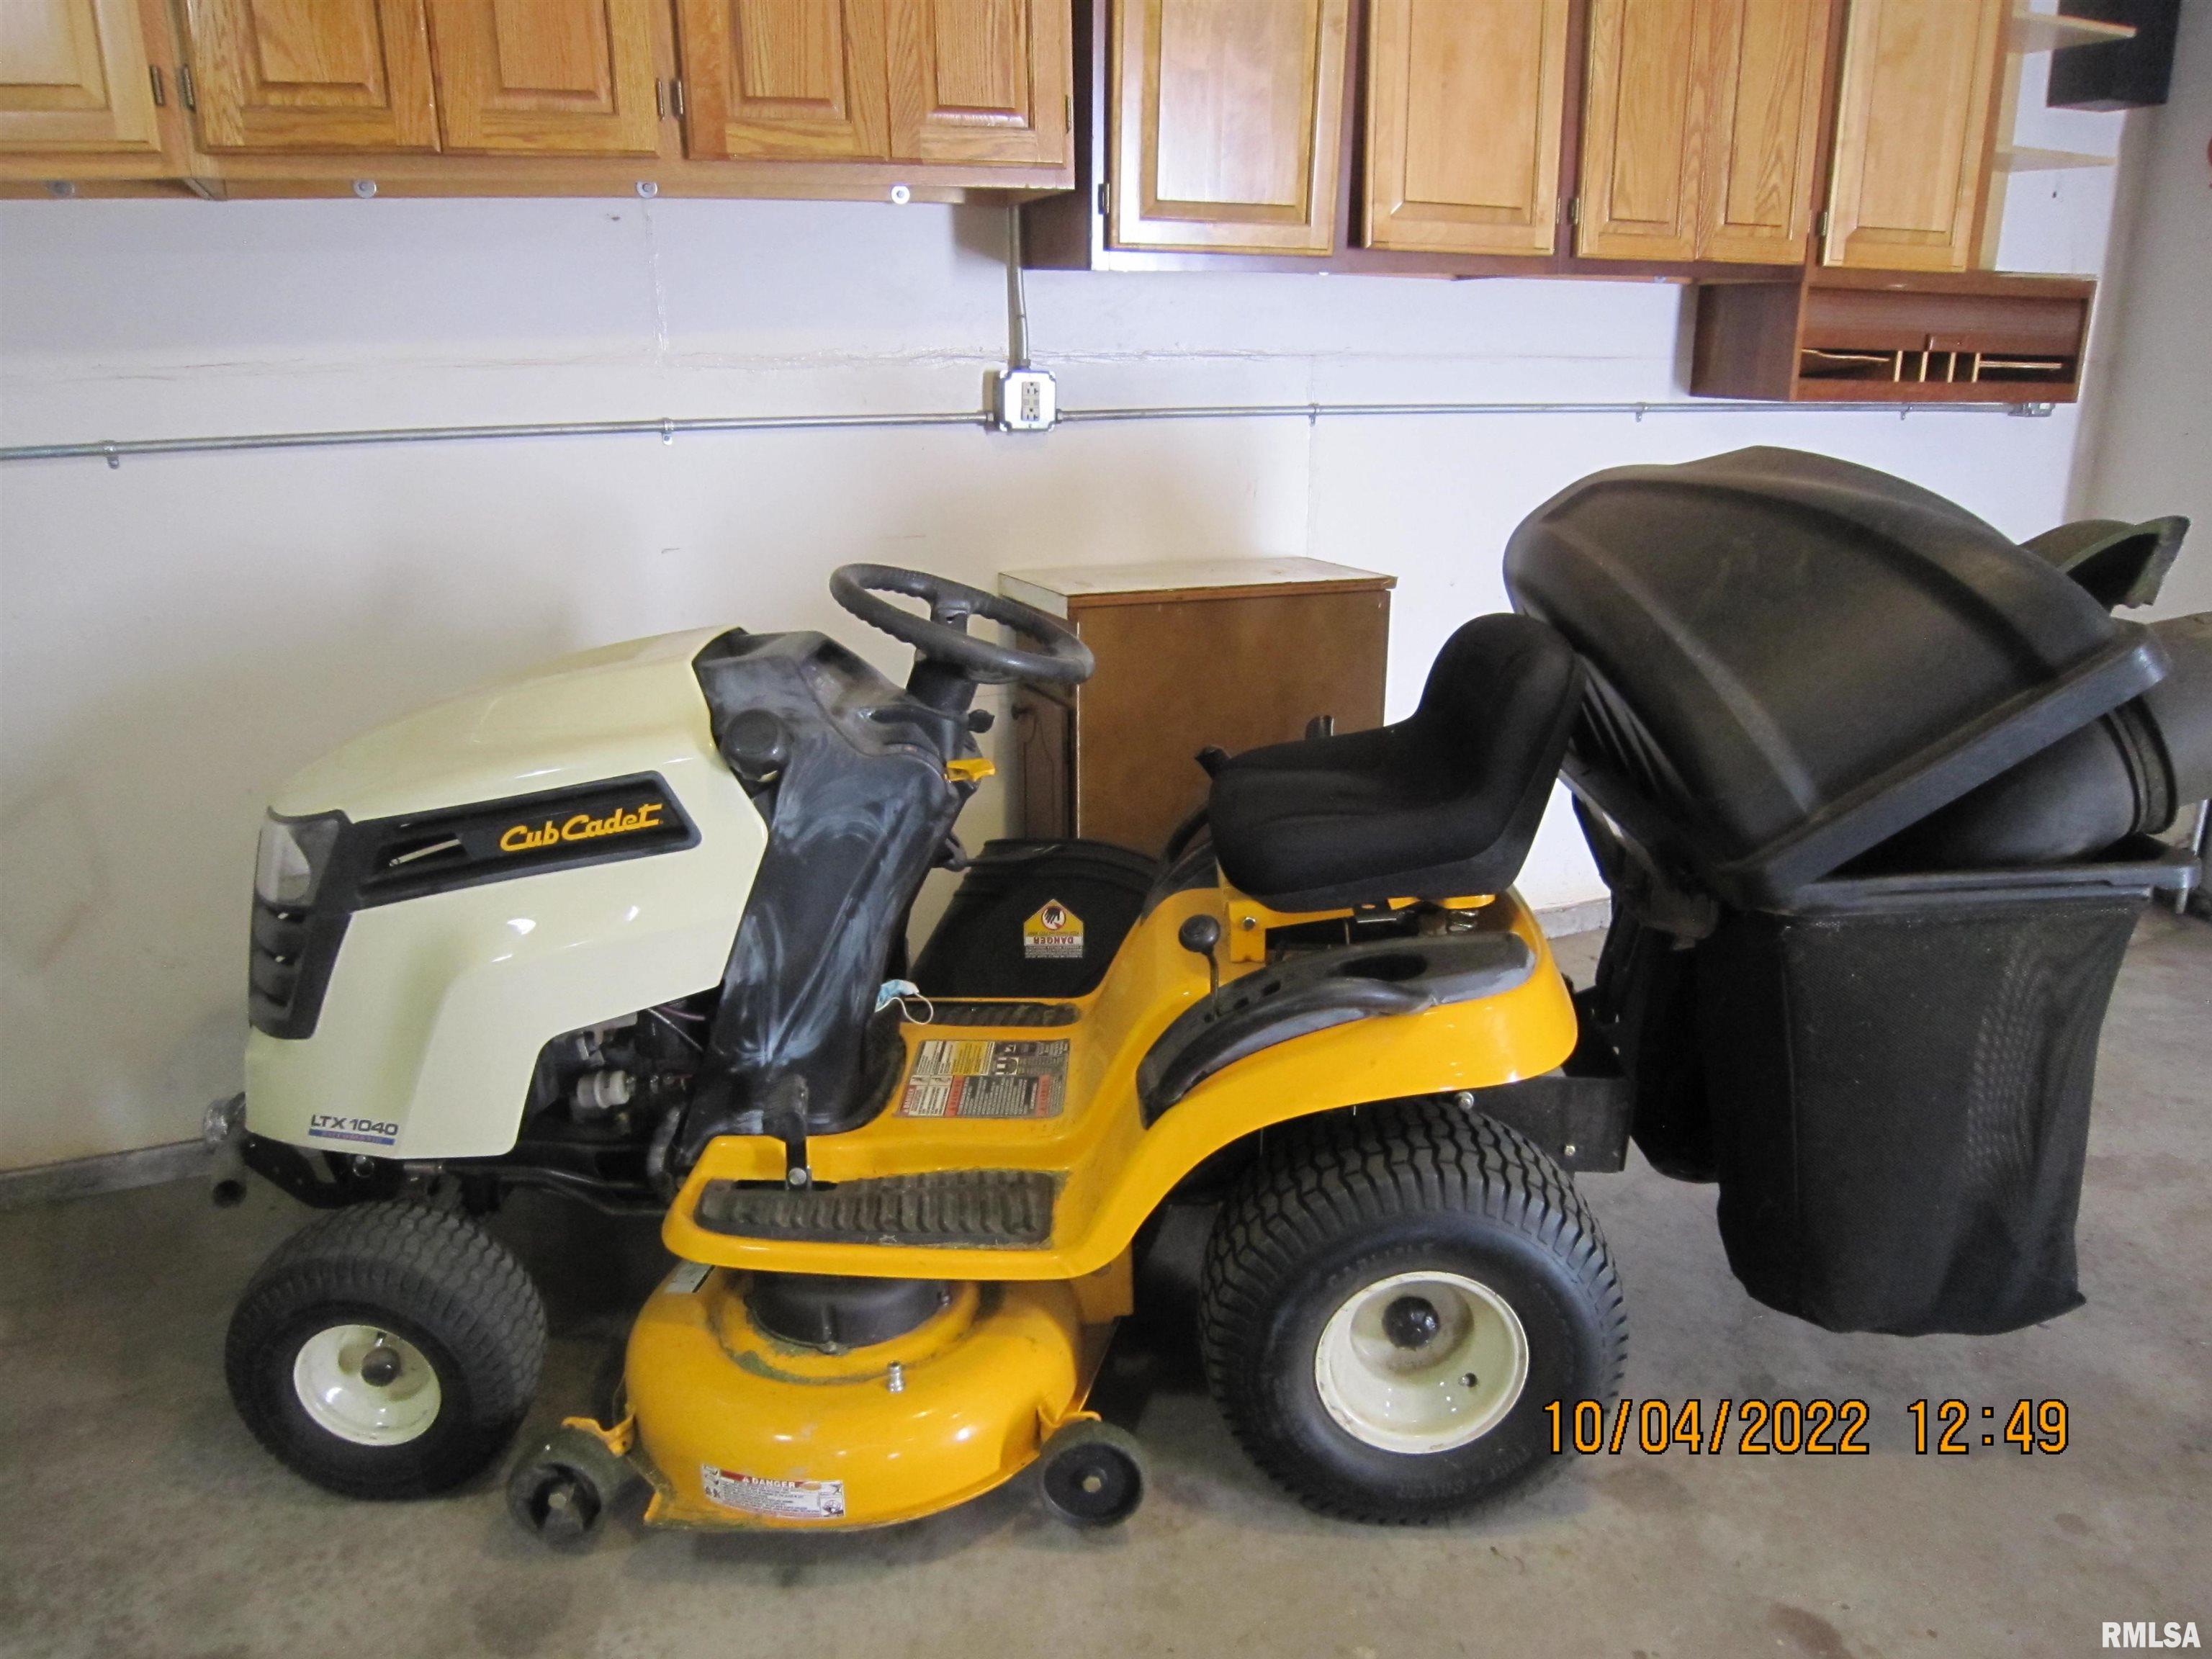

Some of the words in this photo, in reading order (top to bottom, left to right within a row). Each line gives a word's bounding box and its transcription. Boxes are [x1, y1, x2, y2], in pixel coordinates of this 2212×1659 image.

[500, 820, 560, 852] Cub
[561, 803, 662, 841] Cadet
[1033, 936, 1074, 945] DANGER
[310, 1114, 347, 1130] LTX
[349, 1118, 399, 1136] 1040
[752, 1477, 796, 1488] DANGER
